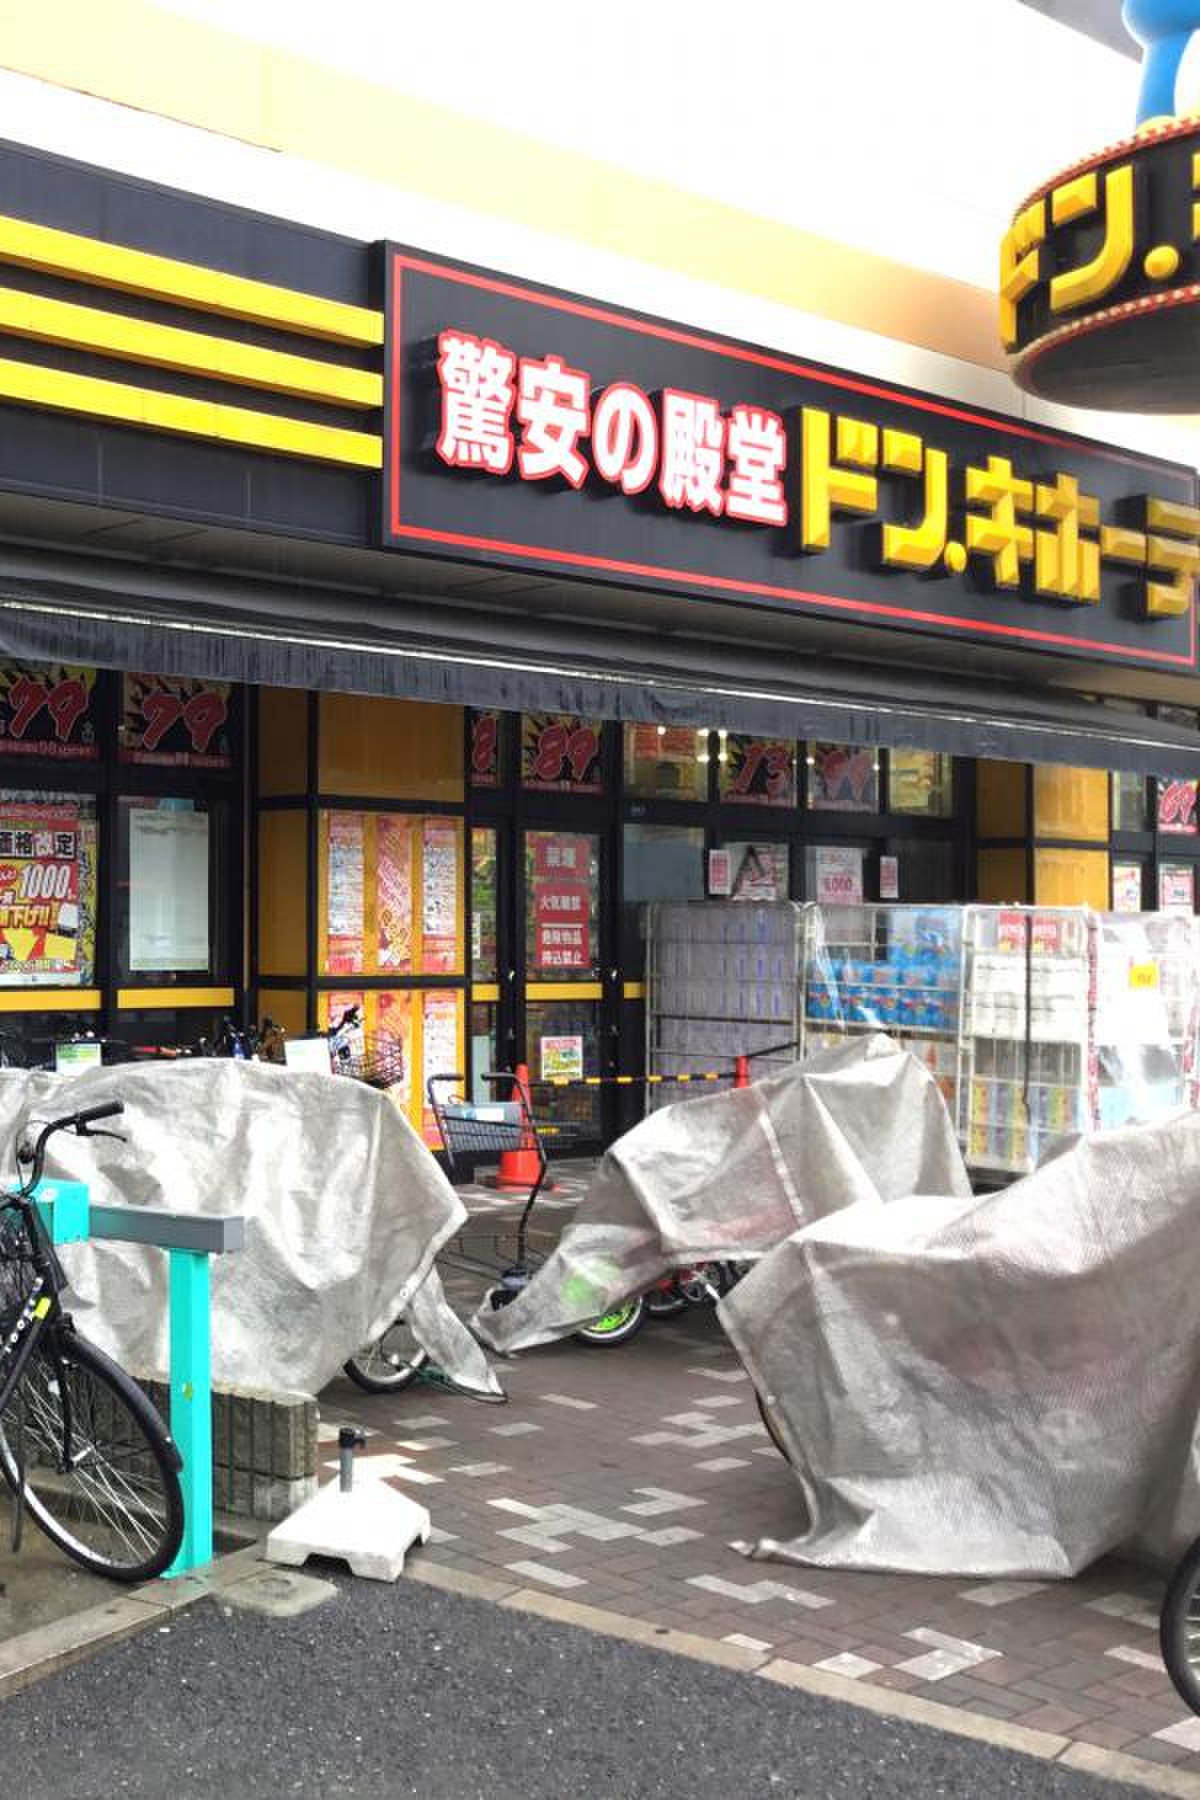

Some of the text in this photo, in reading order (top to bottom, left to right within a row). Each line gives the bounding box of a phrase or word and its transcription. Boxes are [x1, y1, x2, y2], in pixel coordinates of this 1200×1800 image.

[437, 327, 790, 527] 驚安の殿堂
